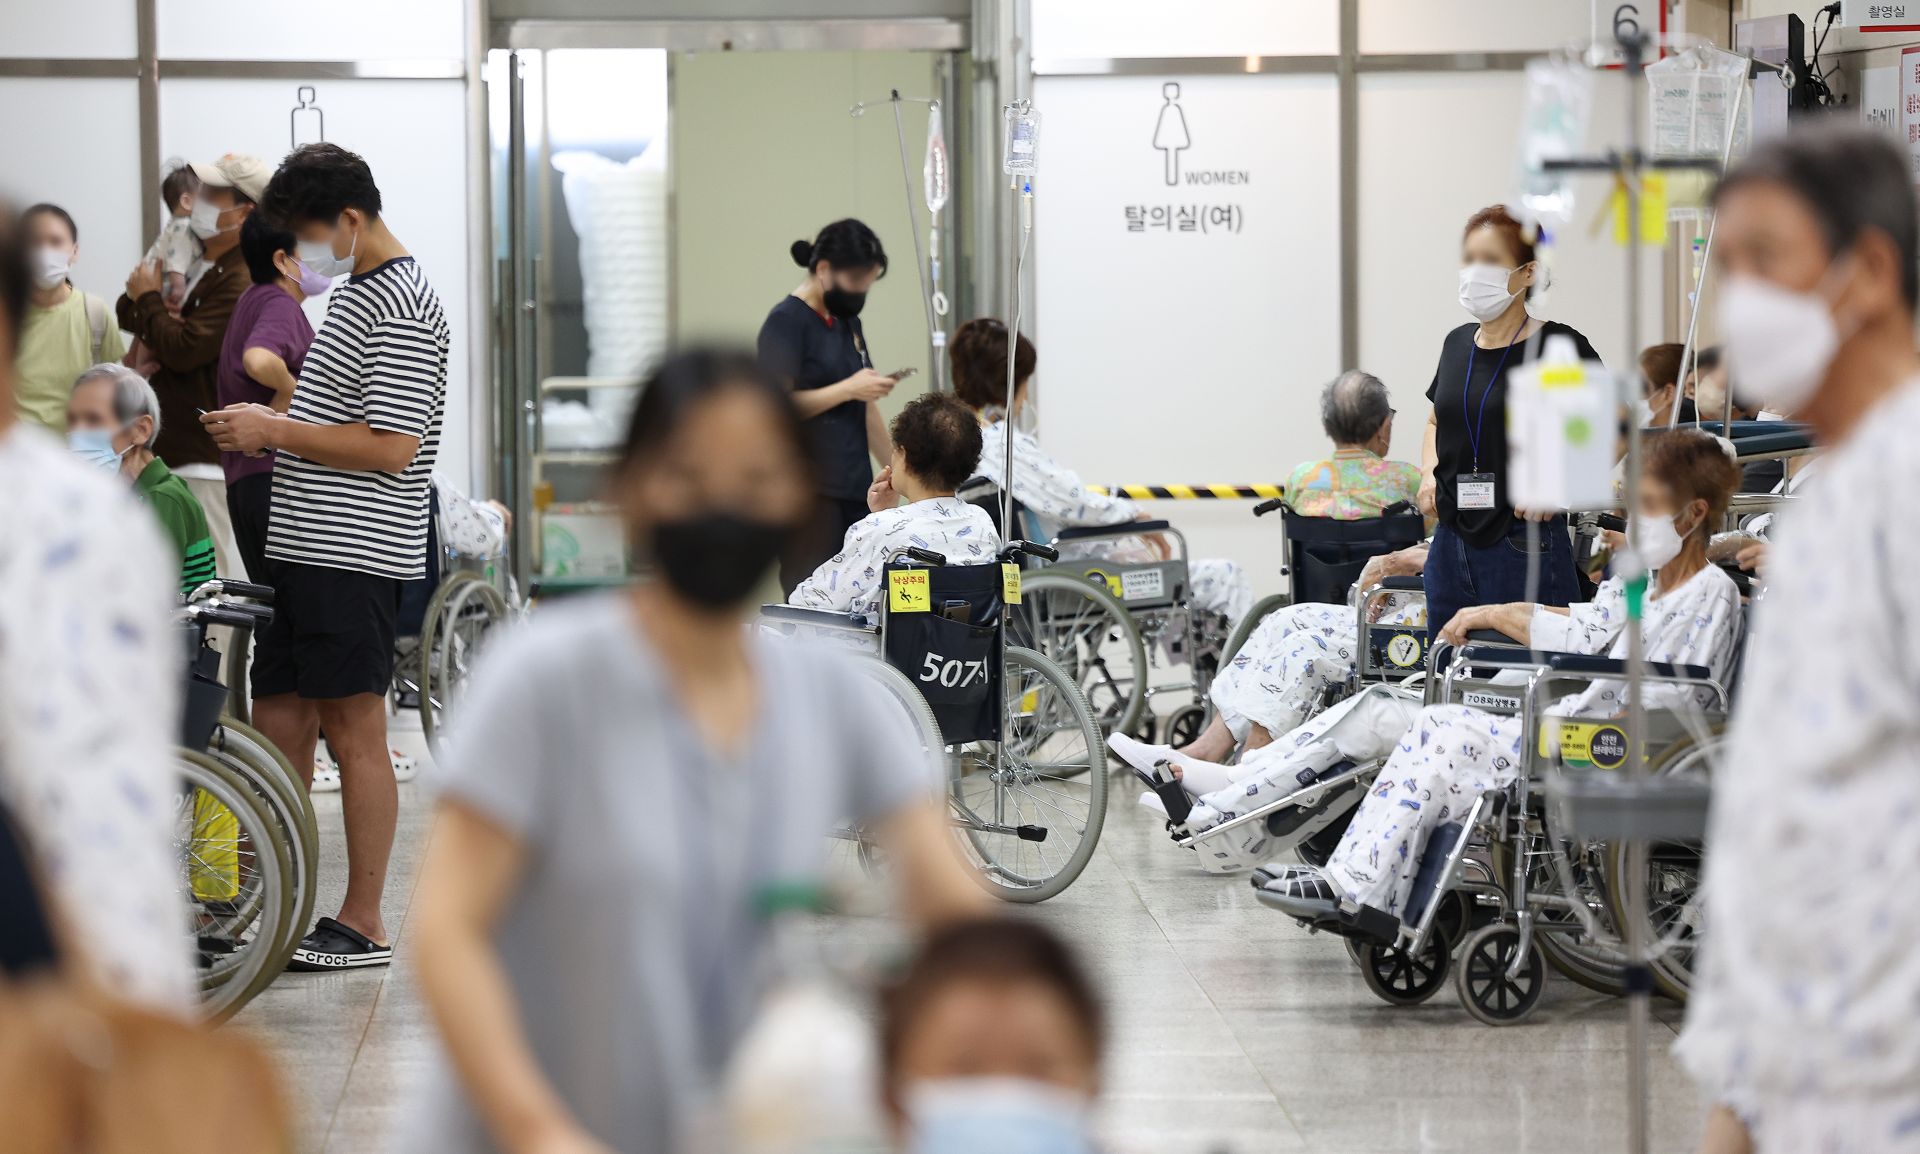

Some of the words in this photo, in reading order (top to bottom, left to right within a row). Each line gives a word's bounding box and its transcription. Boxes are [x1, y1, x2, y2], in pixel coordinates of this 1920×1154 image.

[1868, 5, 1905, 18] 촬영실
[1613, 4, 1639, 45] 6
[1184, 171, 1250, 186] WOMEN
[1125, 204, 1243, 234] 탈의실(여)
[893, 575, 926, 585] 낙상주의
[1600, 734, 1618, 746] 안전
[1592, 744, 1624, 757] 브레이크
[305, 952, 349, 966] crocs
